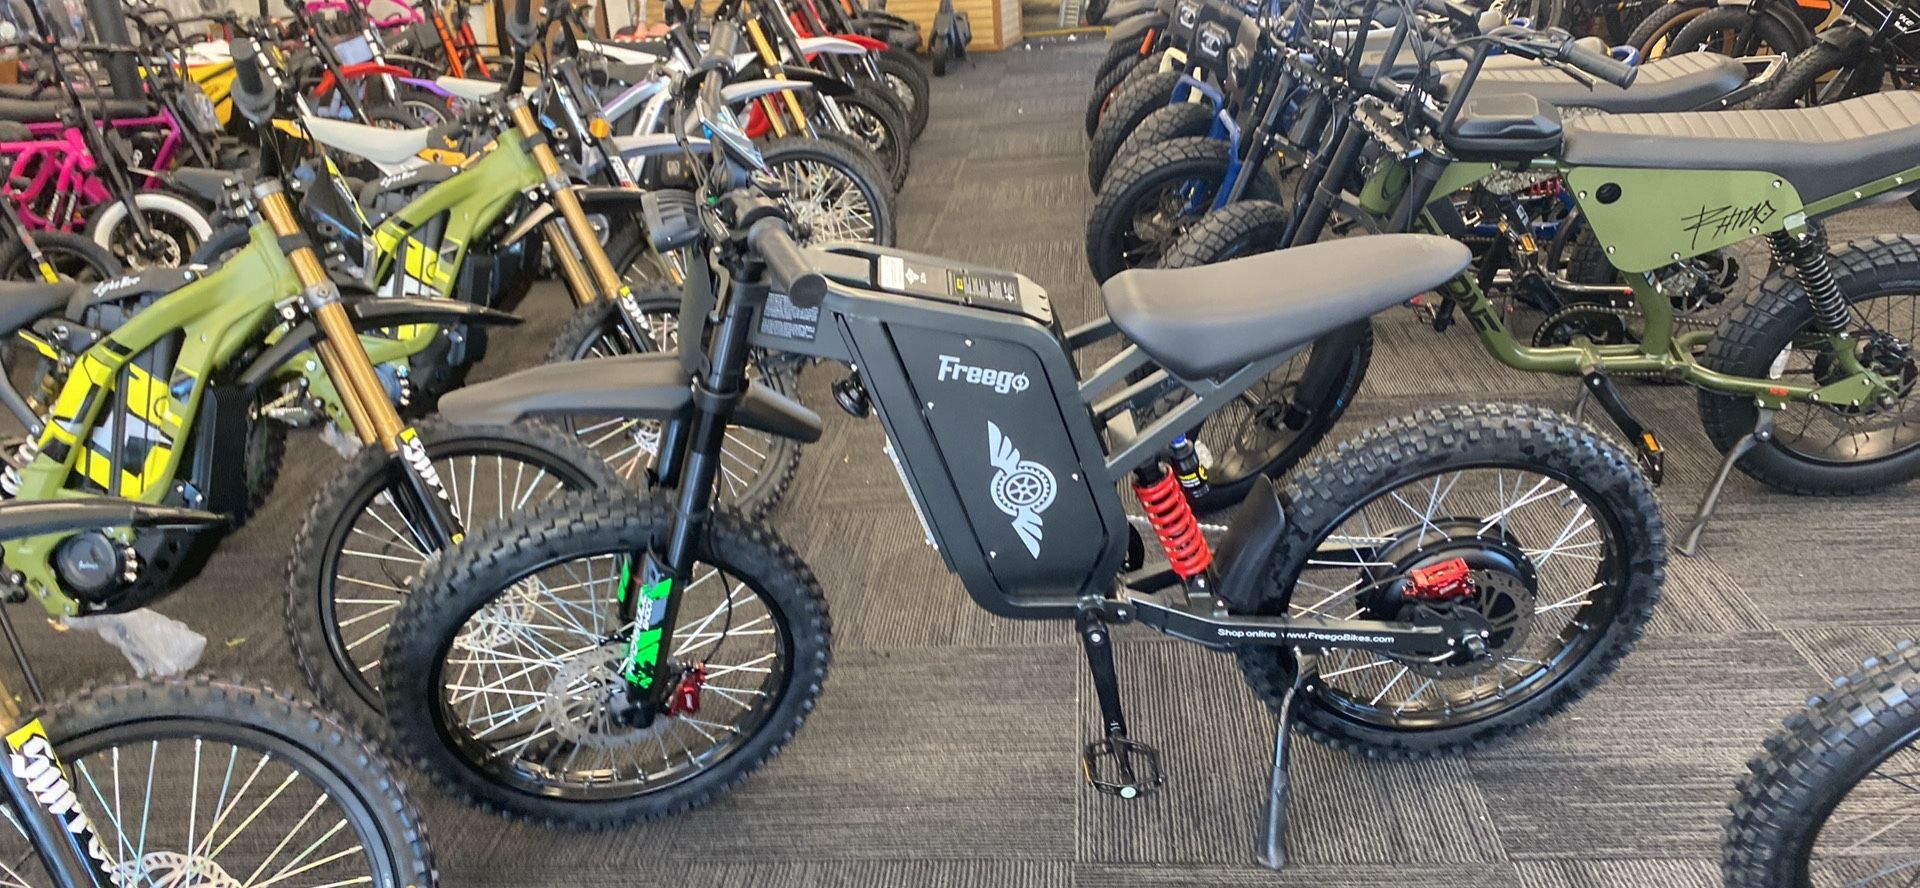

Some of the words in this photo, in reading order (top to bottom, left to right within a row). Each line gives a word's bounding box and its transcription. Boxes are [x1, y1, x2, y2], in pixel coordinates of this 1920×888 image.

[937, 354, 1030, 394] Freego
[1217, 628, 1245, 638] Shop
[1245, 630, 1277, 638] online
